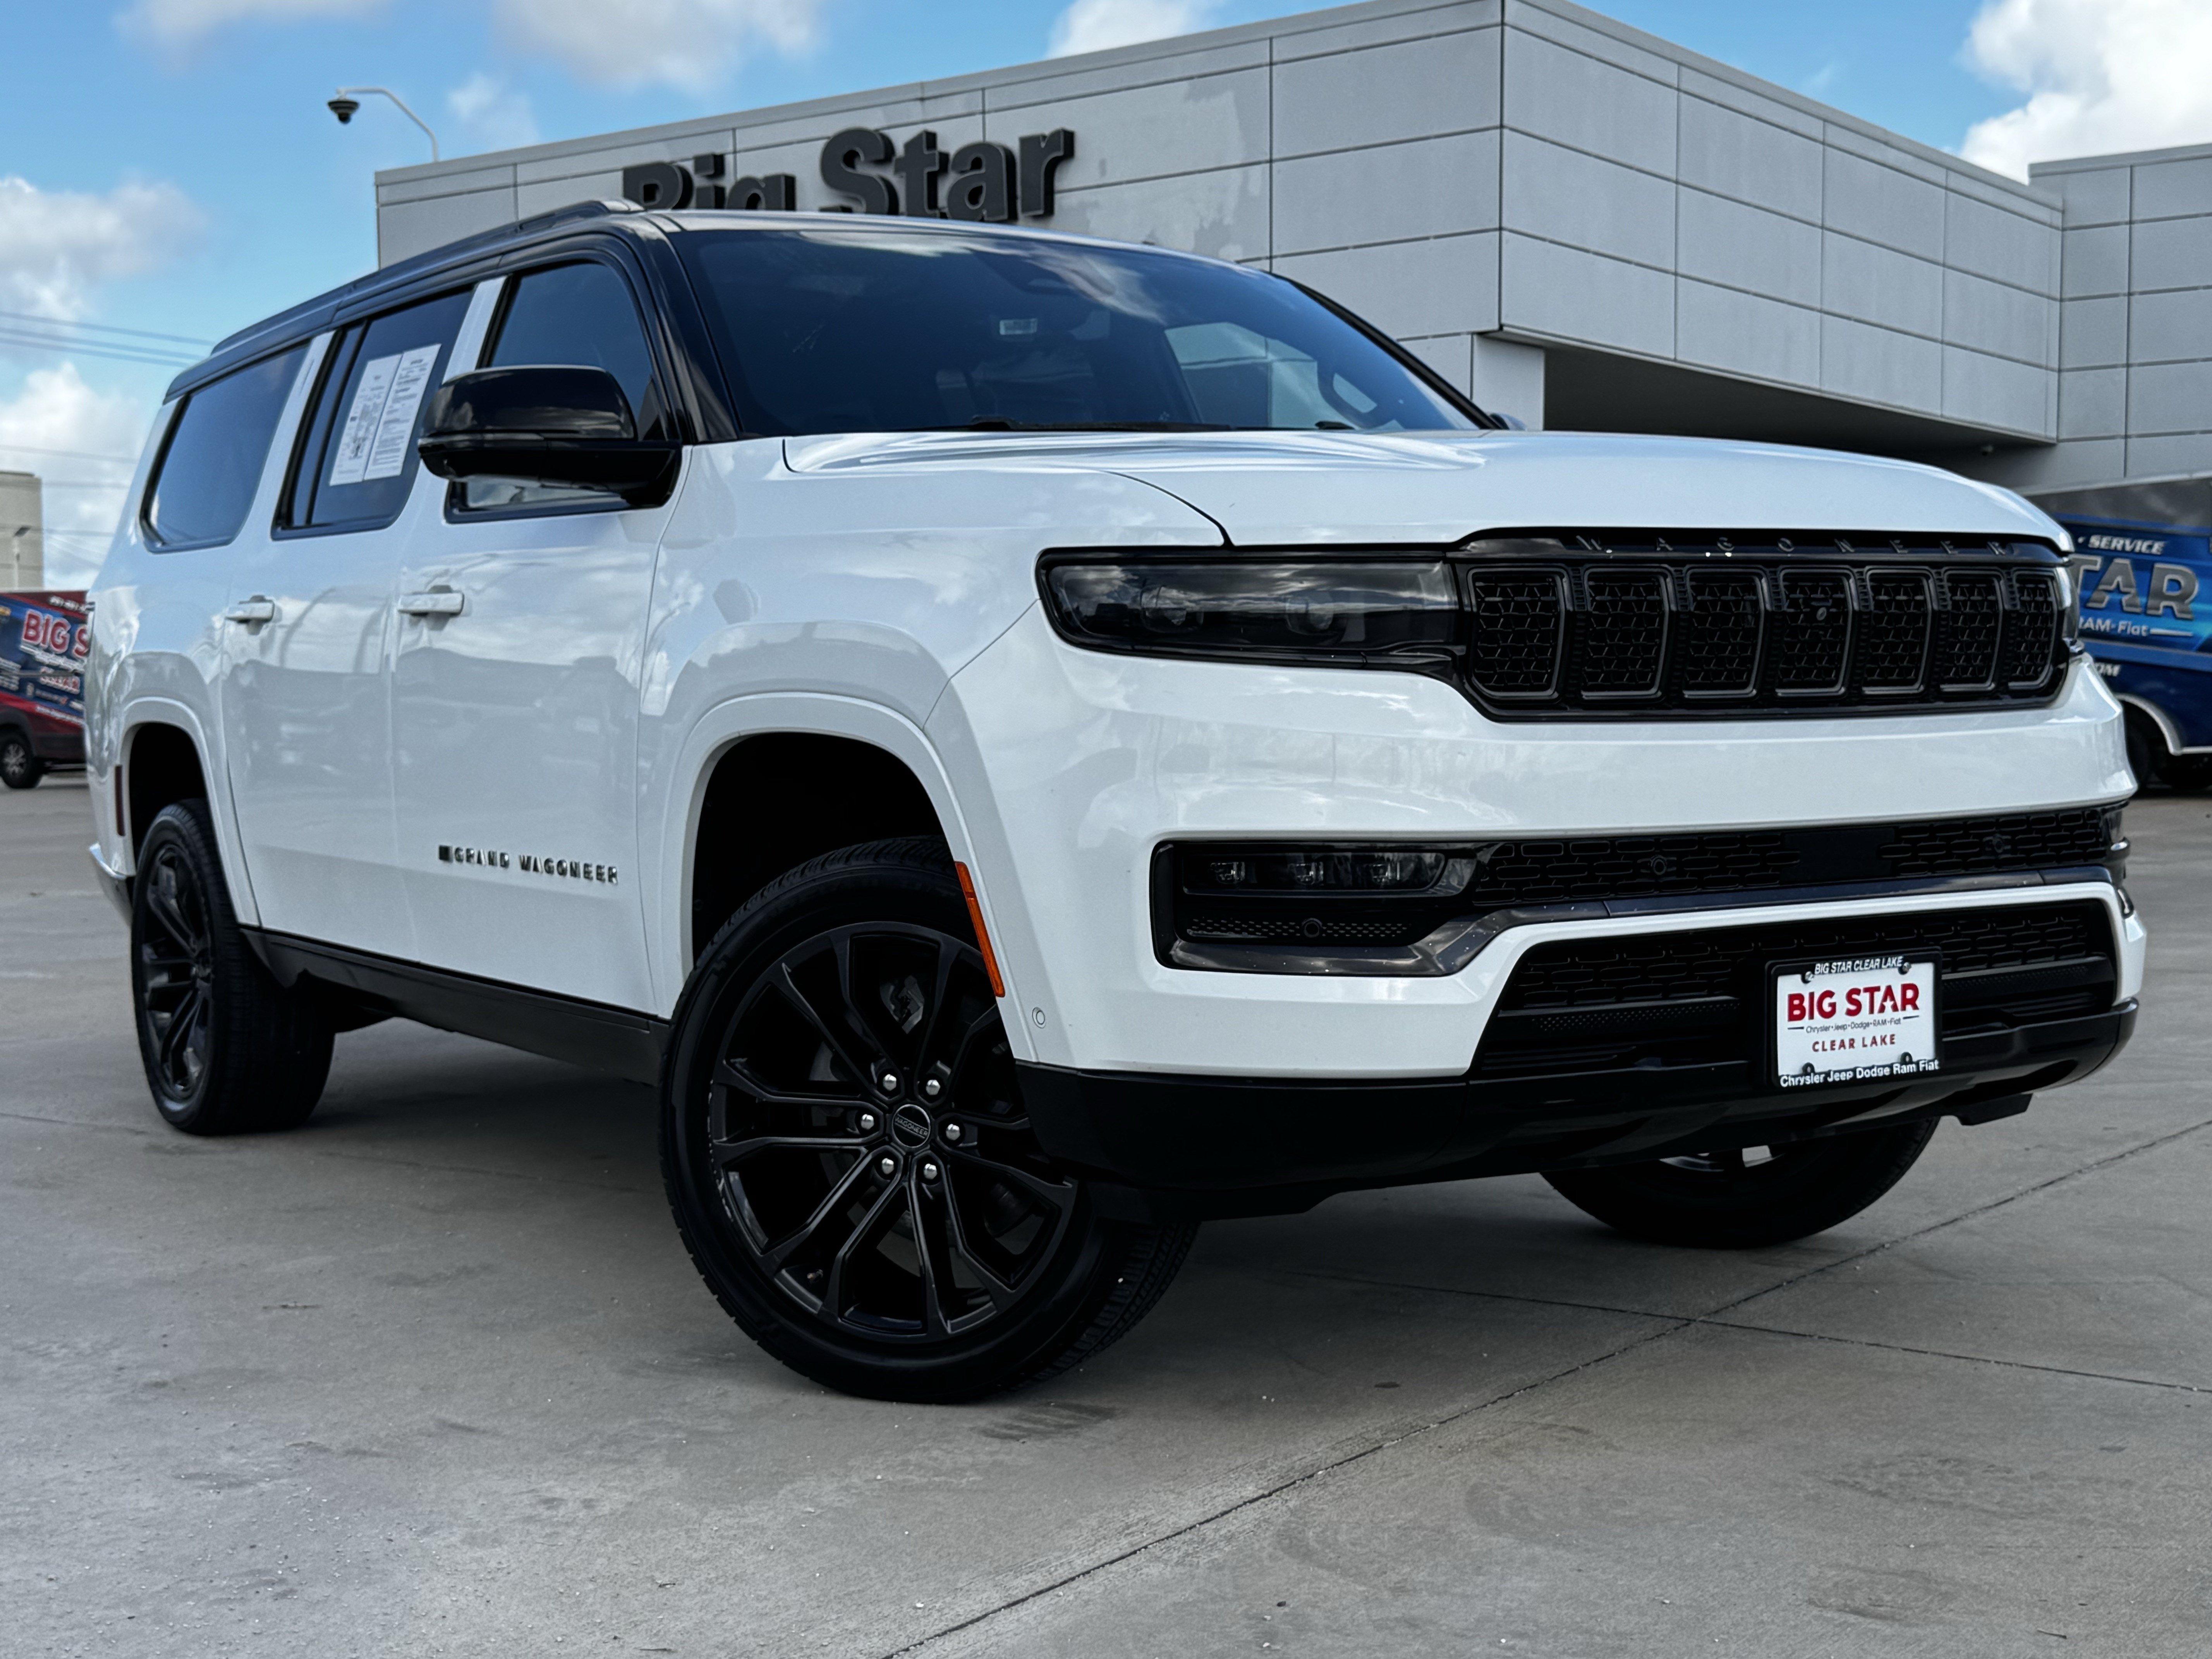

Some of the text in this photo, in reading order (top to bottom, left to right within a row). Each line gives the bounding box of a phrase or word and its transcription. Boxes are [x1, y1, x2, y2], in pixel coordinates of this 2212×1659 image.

[819, 127, 1075, 222] Star
[1575, 535, 2008, 555] WAGONEER
[2088, 534, 2165, 555] SERVICE
[22, 609, 71, 654] BIG
[454, 847, 618, 885] GRAND WAGONEER
[1814, 956, 1904, 974] BIG STAR CLEAR LAKE
[1787, 983, 1920, 1022] BIG STAR
[1812, 1034, 1896, 1052] CLEAR LAKE
[1780, 1059, 1940, 1087] Chrysler Jeep Dodge Ram Fiat
